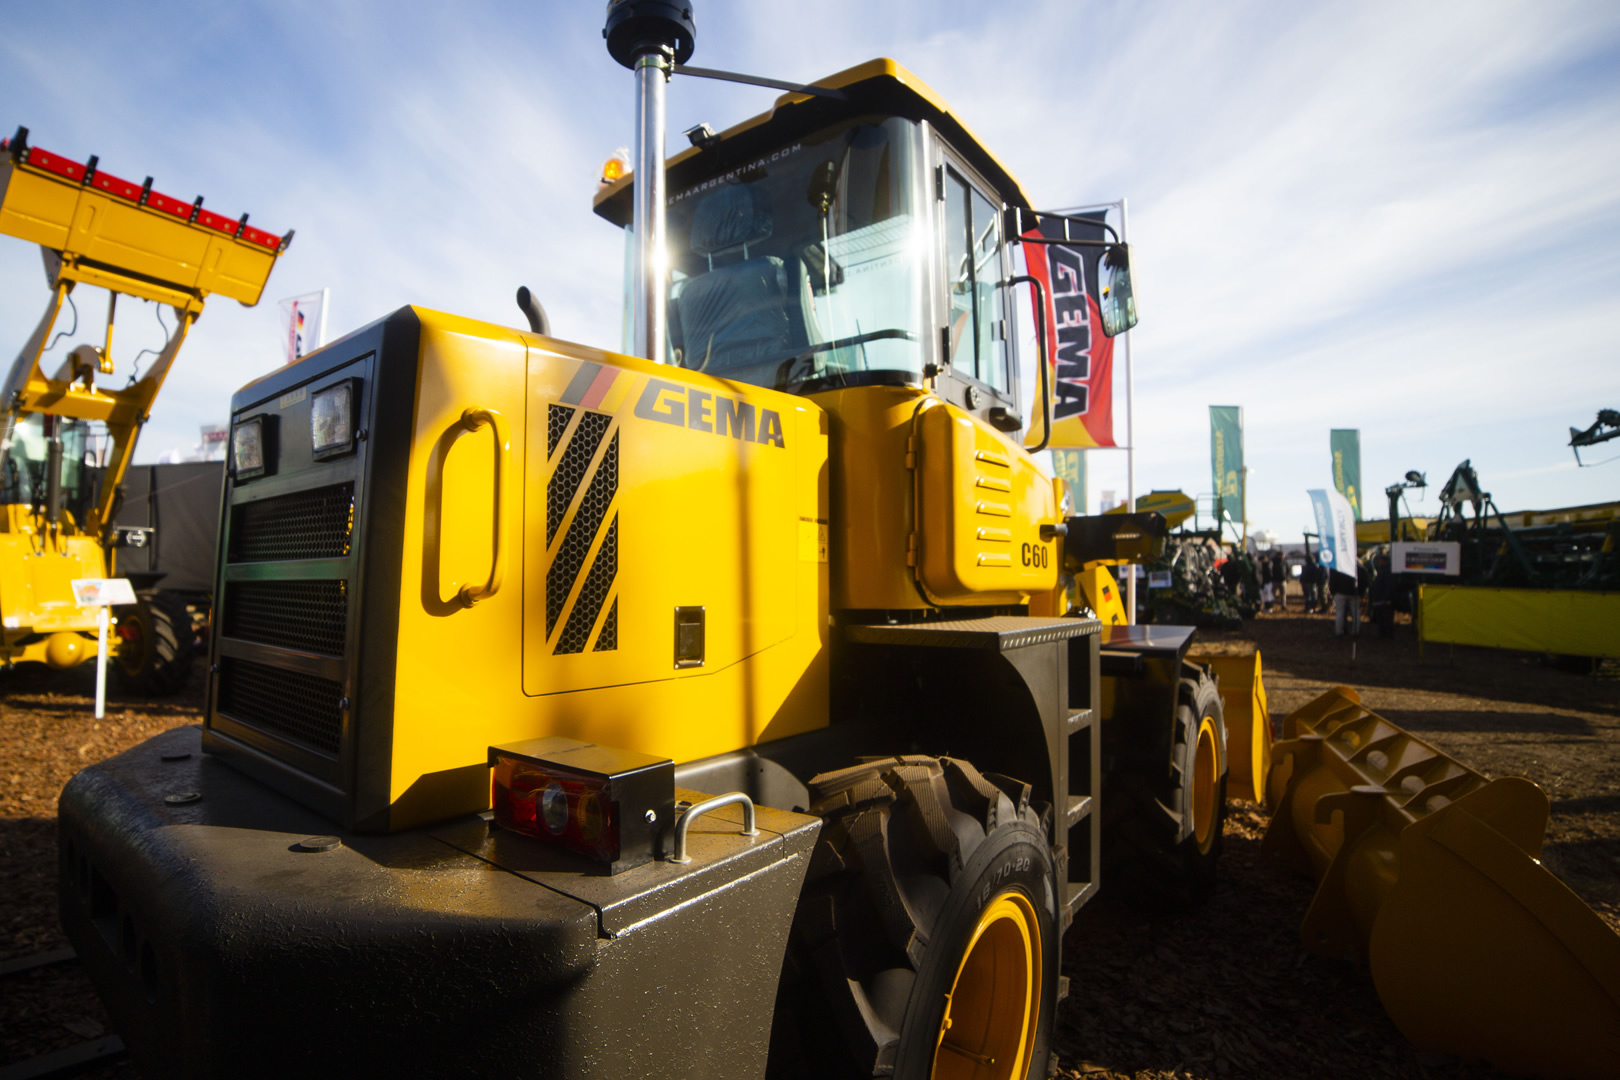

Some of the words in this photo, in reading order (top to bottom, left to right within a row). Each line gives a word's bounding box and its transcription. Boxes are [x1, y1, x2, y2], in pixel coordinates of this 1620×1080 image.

[664, 142, 802, 206] EMAARGENTINA.COM
[1046, 244, 1090, 423] GEMA
[634, 378, 785, 449] GEMA
[1021, 542, 1048, 569] C60
